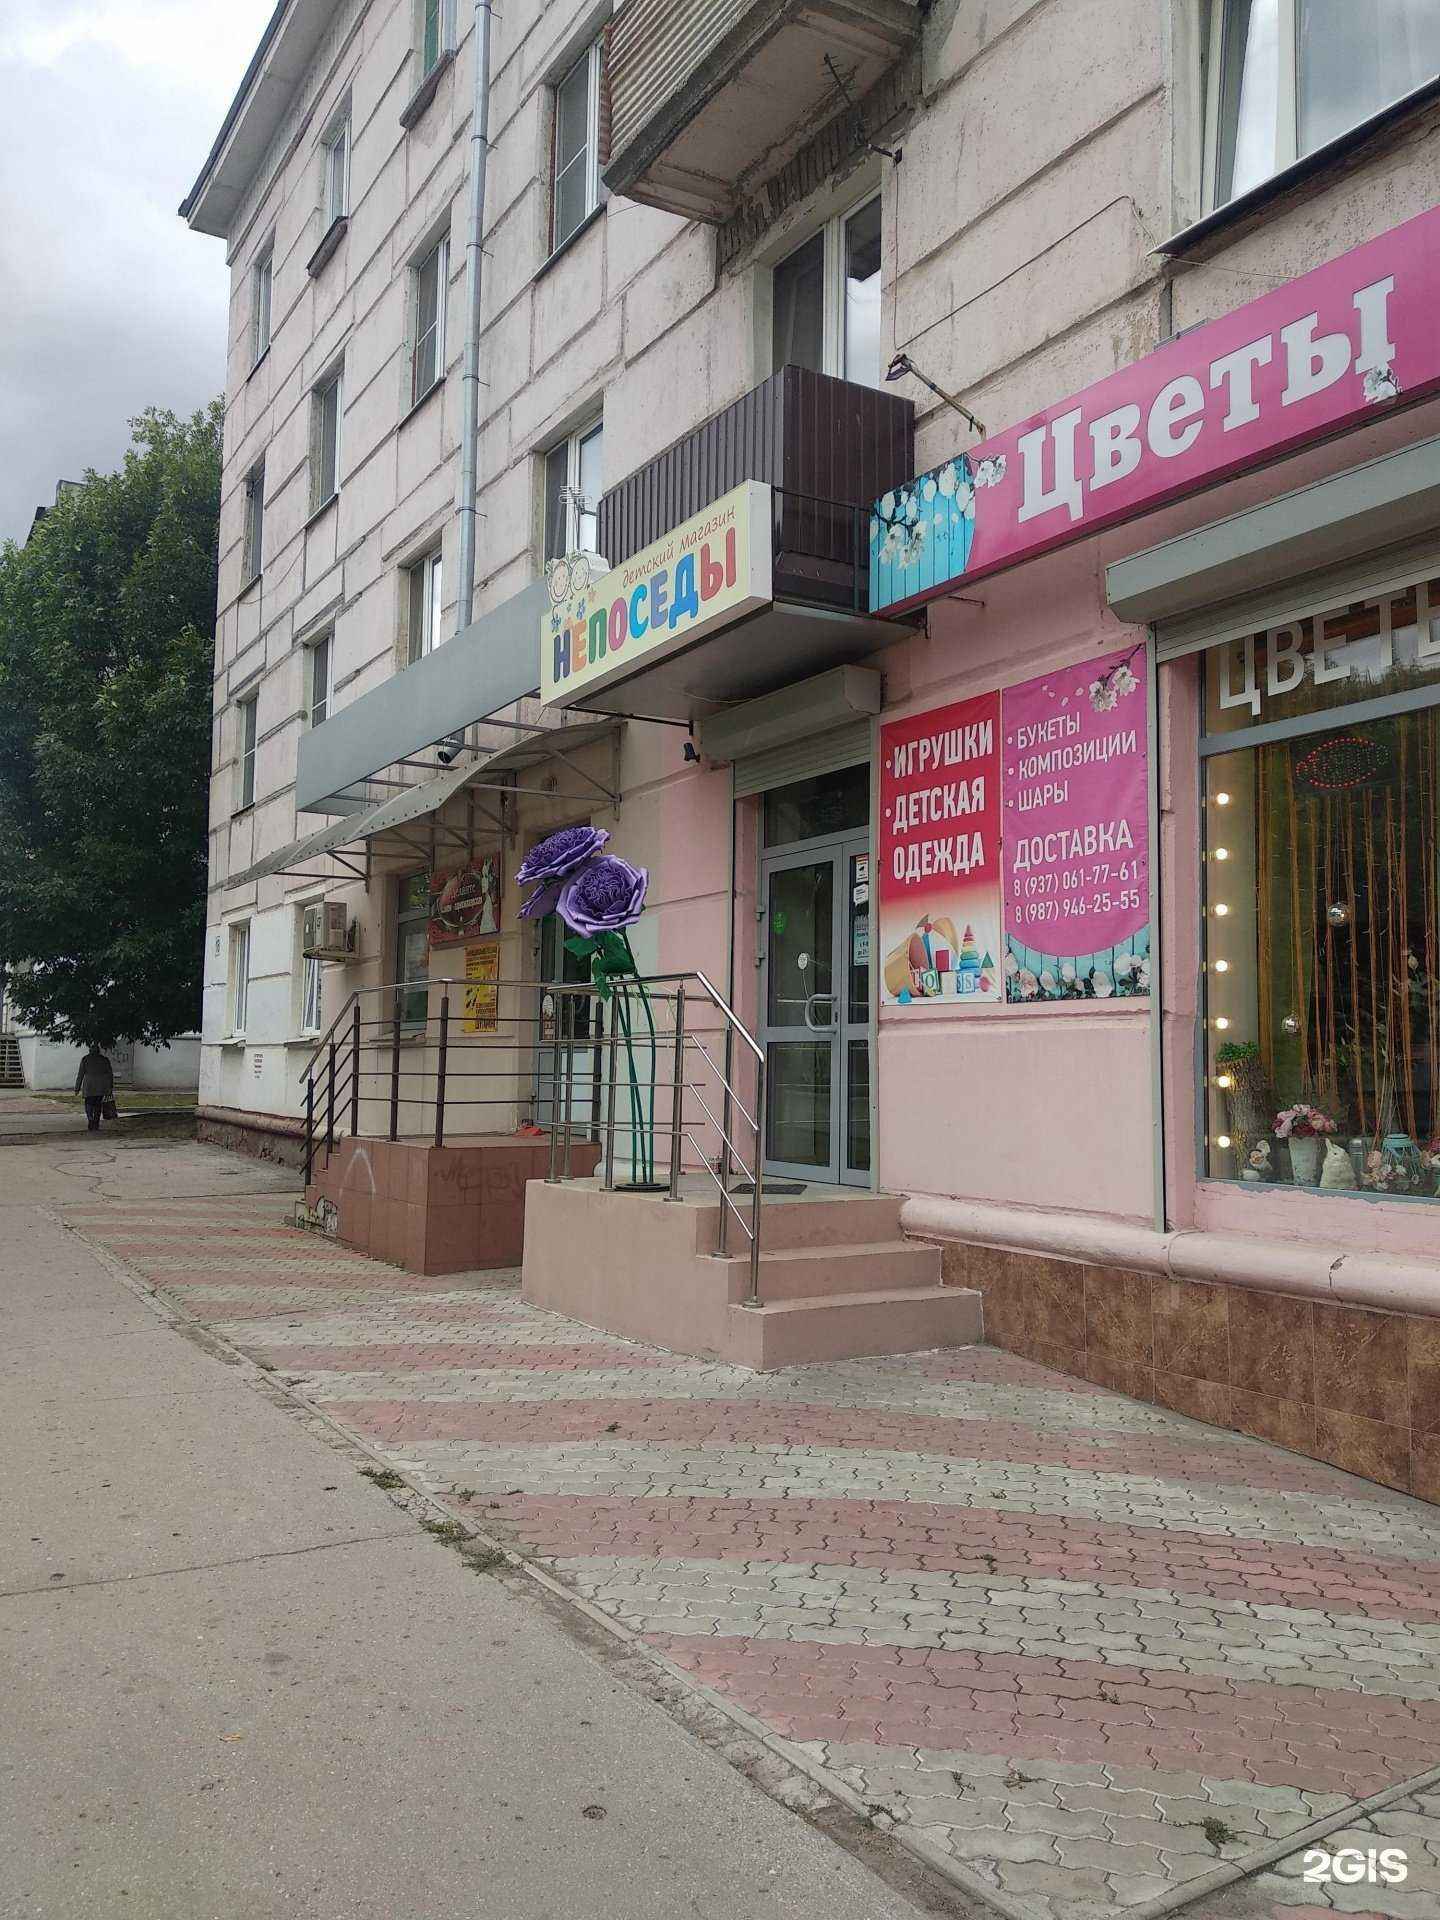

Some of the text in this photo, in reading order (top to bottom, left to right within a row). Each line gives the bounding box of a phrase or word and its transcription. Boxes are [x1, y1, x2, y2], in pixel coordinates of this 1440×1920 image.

[553, 526, 737, 683] НЕПОСЕДЫ
[893, 719, 993, 779] ИГРУШКИ
[1016, 711, 1080, 750] БУКЕТЫ
[1018, 730, 1136, 780] КОМПОЗИЦИИ
[892, 776, 985, 835] ДЕТСКАЯ
[1018, 781, 1069, 812] ШАРЫ
[893, 831, 985, 884] ОДЕЖДА
[1013, 819, 1134, 873] ДОСТАВКА
[1013, 860, 1138, 897] 8 (937) 061-77-61
[1015, 889, 1140, 924] 8 (987) 946-25-55
